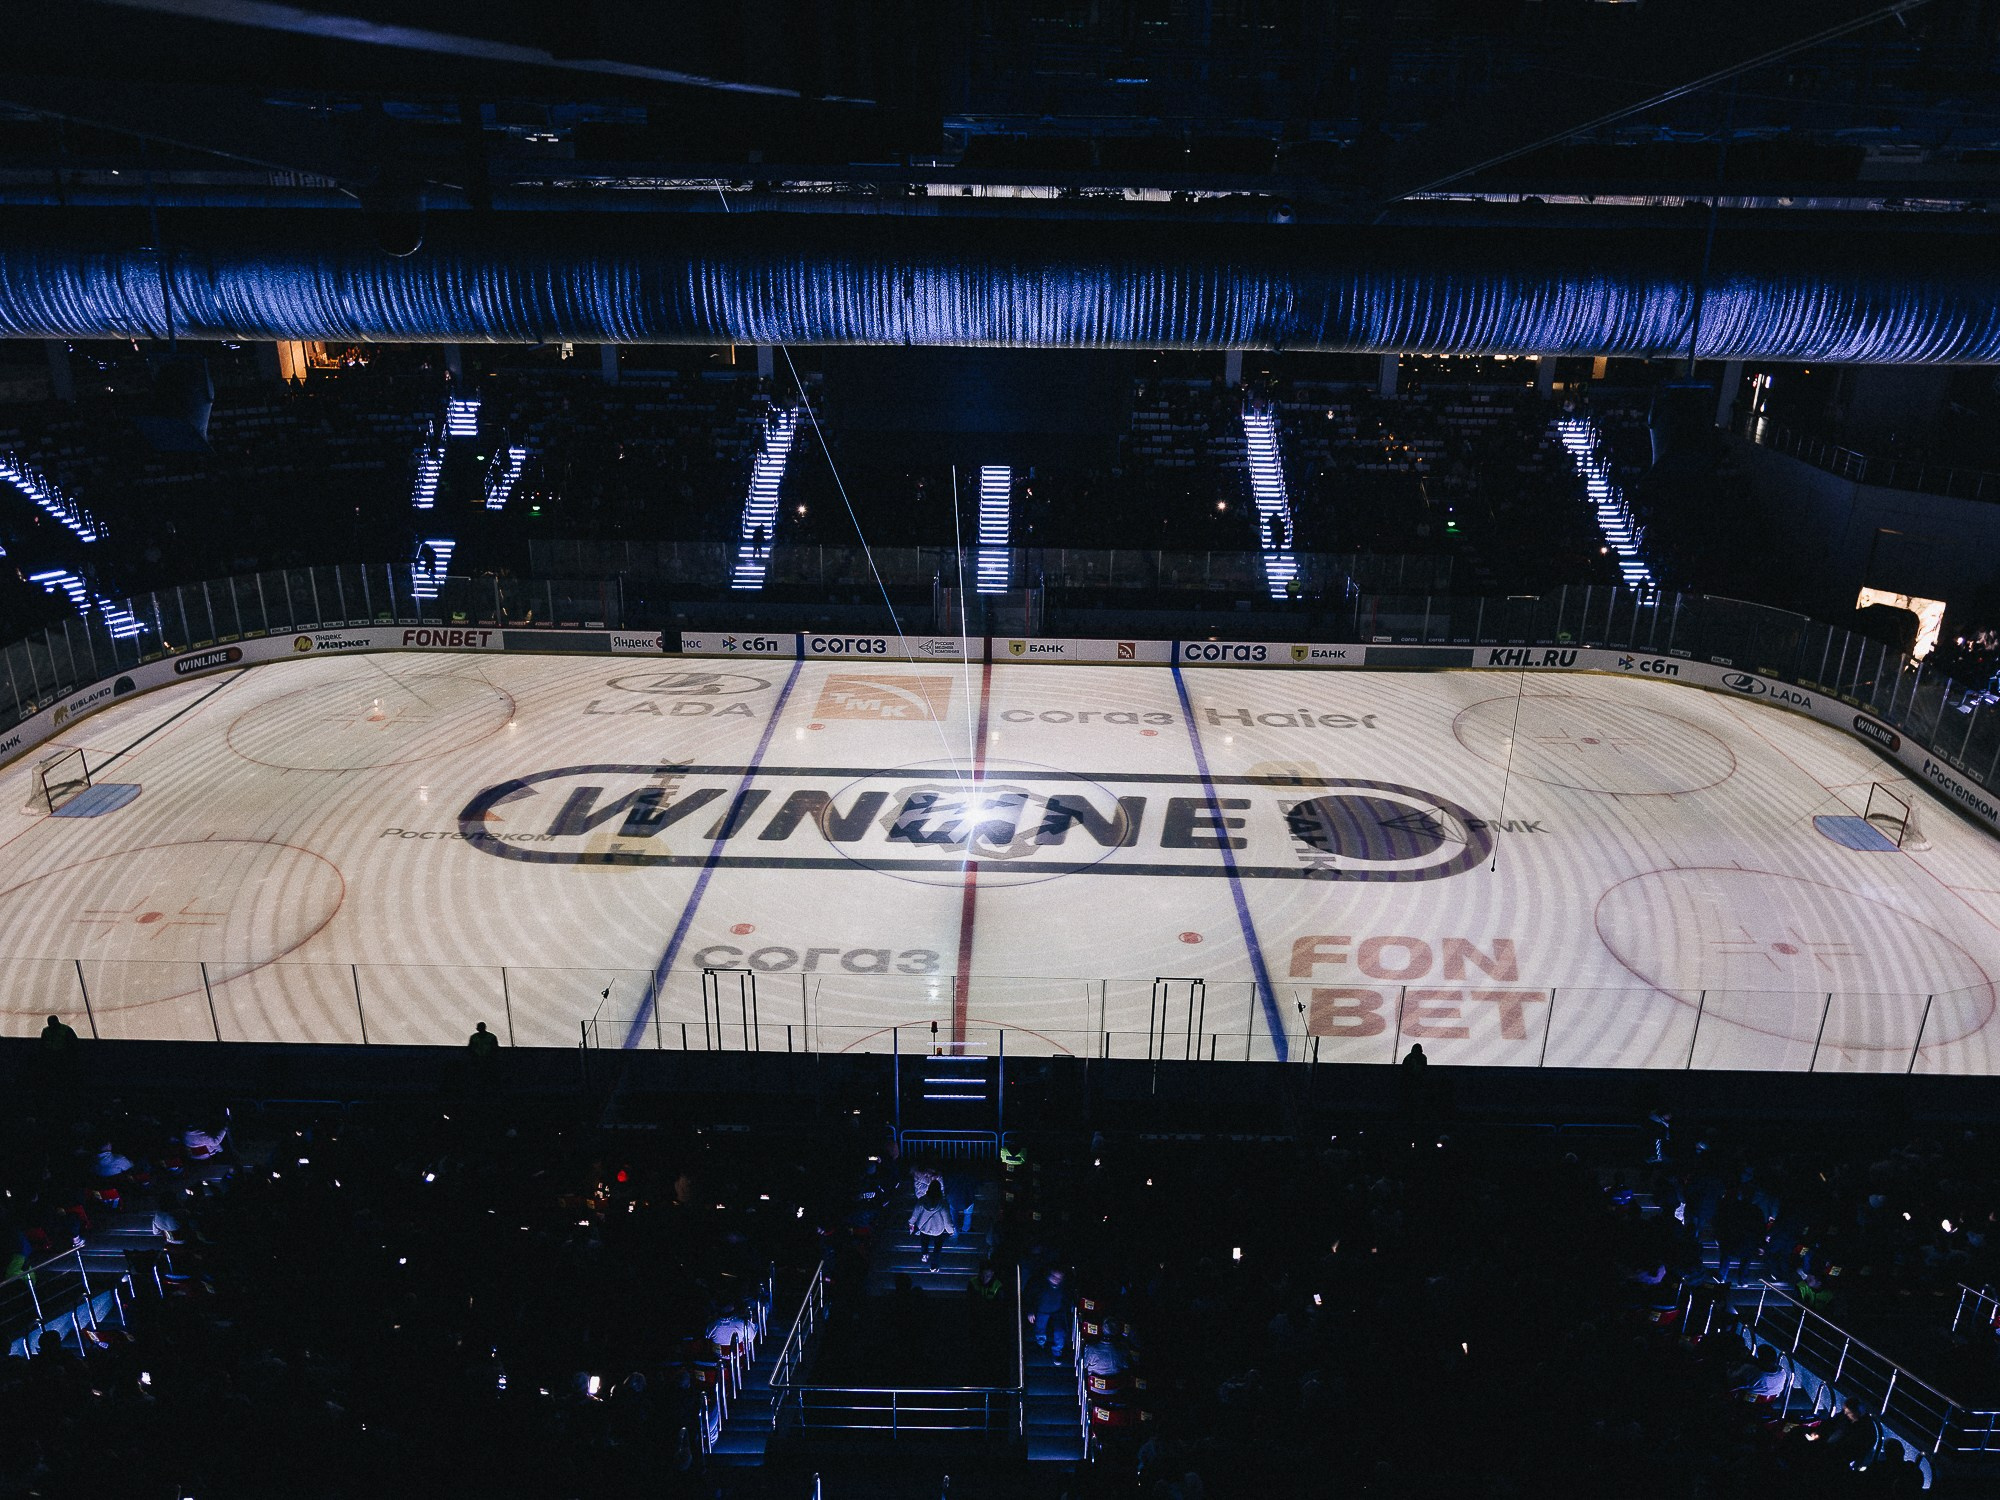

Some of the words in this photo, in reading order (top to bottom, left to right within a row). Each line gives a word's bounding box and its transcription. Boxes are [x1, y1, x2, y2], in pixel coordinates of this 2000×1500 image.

[315, 633, 342, 641] Яндекс
[316, 639, 370, 650] Маркет
[402, 630, 493, 647] FONBET
[613, 636, 654, 648] Яндекс
[742, 637, 778, 651] сбп
[812, 638, 886, 654] согаз
[1030, 644, 1064, 653] БАНК
[1185, 644, 1267, 661] согаз
[1312, 650, 1346, 658] БАНК
[179, 652, 228, 672] WINLINE
[1488, 649, 1578, 666] KHL.RU
[1640, 659, 1678, 676] сбп
[70, 687, 112, 712] GISLAVED
[830, 692, 908, 718] ТМК
[1770, 686, 1812, 709] LADA
[582, 700, 757, 718] LADA
[1000, 709, 1175, 726] согаз
[1204, 708, 1378, 730] Haier
[1857, 718, 1893, 745] WINLINE
[1930, 764, 1998, 822] Ростелеком
[379, 828, 558, 842] Ростелеком
[692, 945, 940, 974] согаз
[1288, 935, 1519, 982] FON
[1308, 987, 1546, 1040] BET
